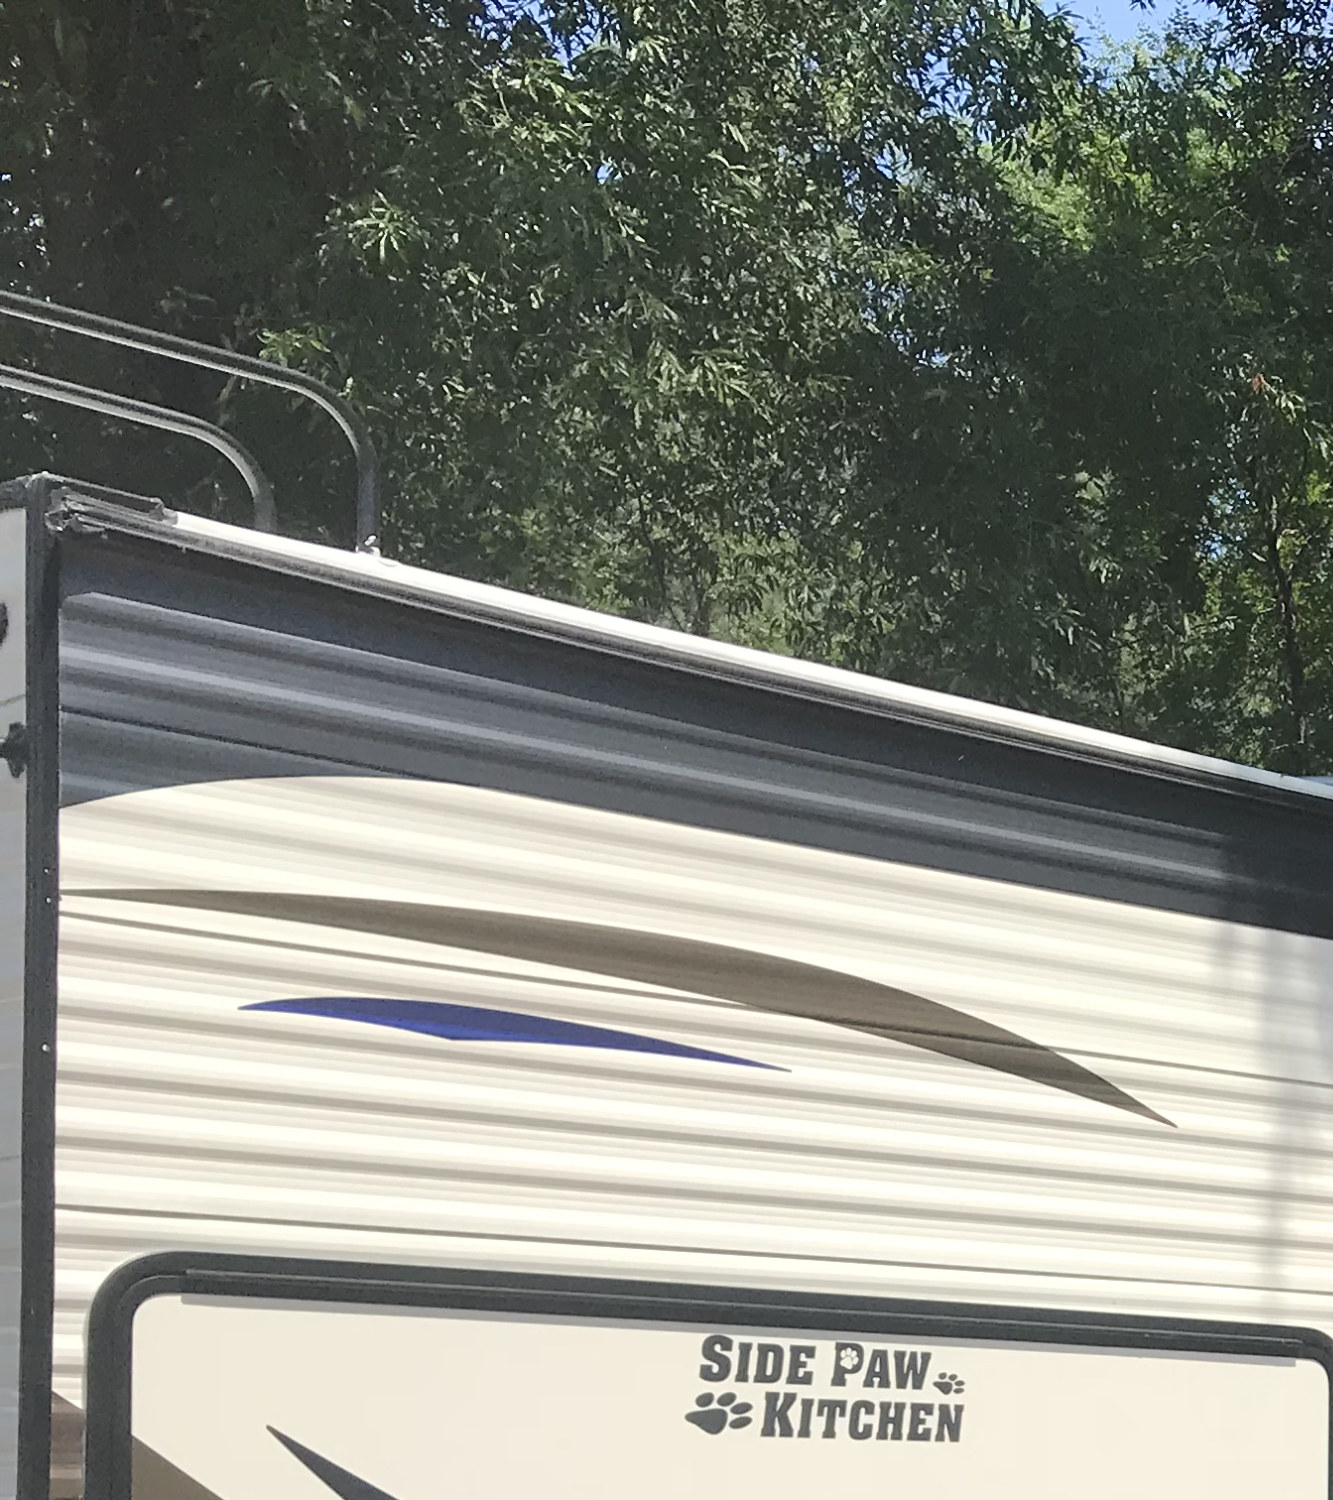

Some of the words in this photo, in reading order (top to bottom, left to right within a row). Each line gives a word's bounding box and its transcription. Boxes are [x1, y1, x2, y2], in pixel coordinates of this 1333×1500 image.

[699, 1334, 816, 1385] SIDE
[831, 1341, 932, 1390] PAW
[760, 1392, 964, 1442] KITCHEN
